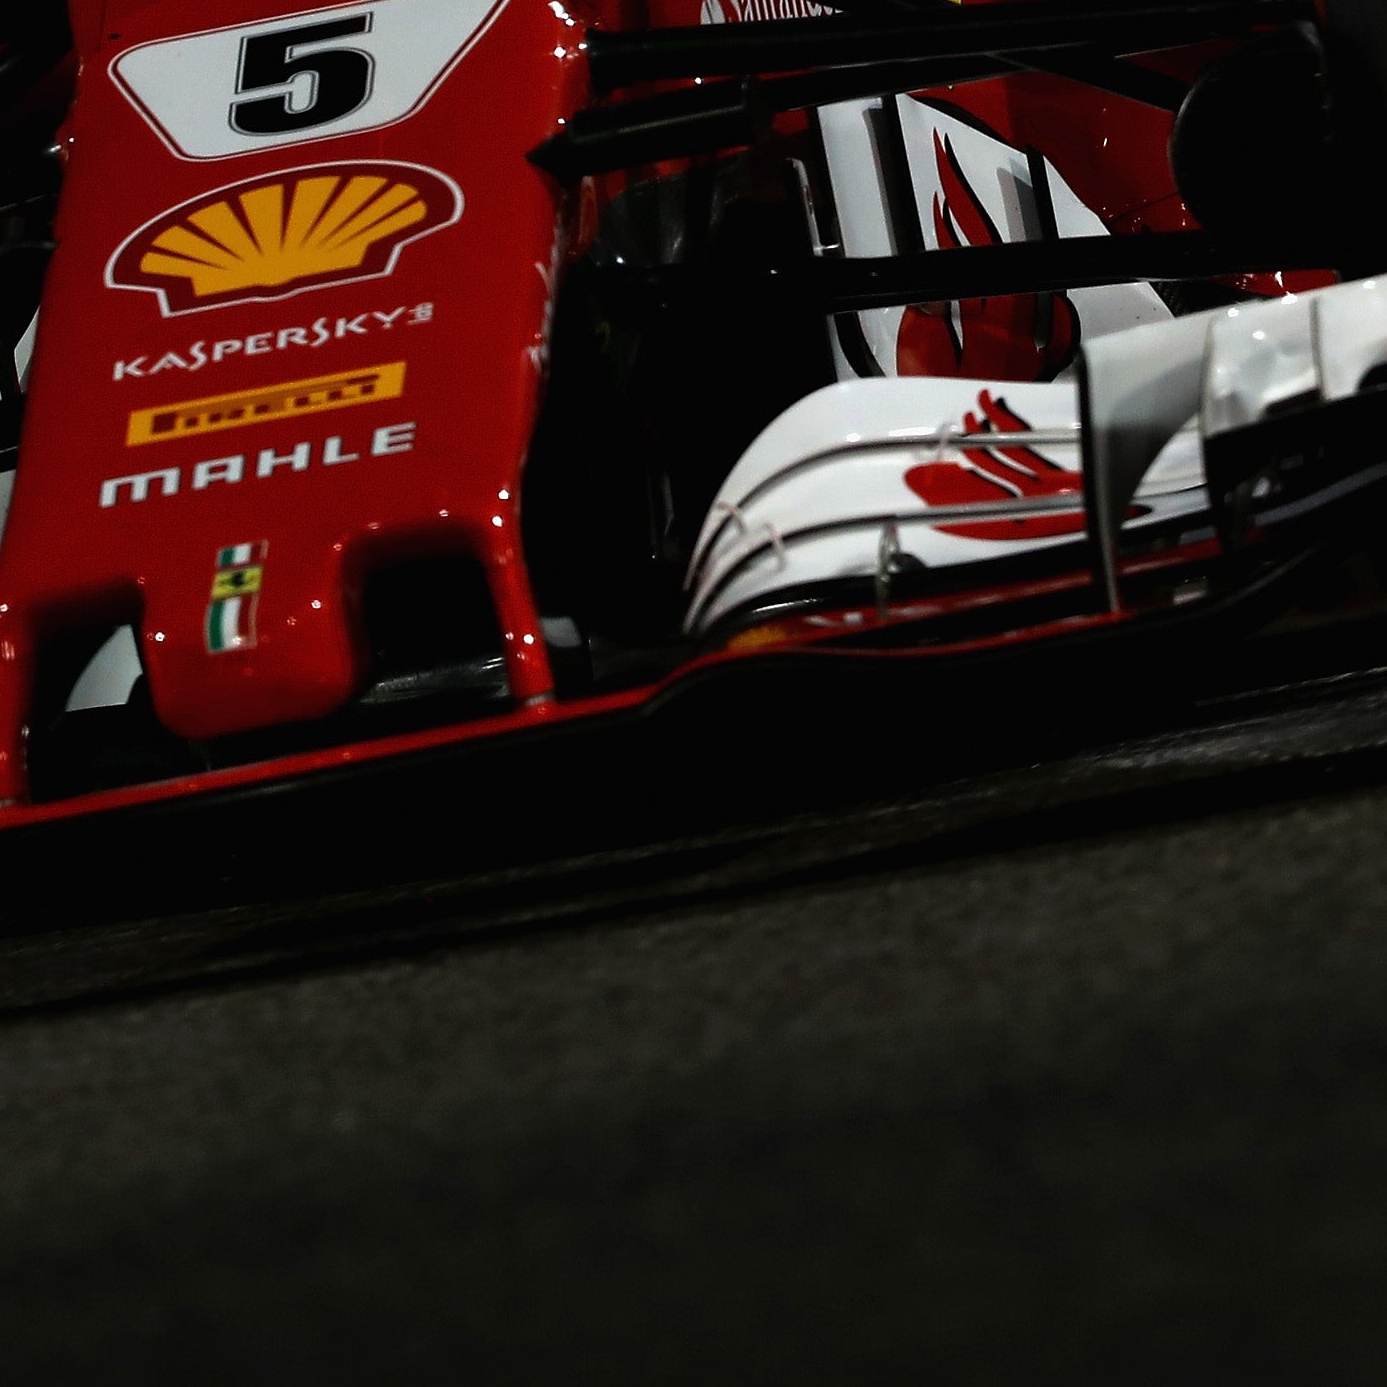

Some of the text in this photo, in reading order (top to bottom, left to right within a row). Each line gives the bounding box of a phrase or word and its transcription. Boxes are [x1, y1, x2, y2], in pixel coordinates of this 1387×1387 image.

[228, 11, 374, 136] 5
[112, 306, 406, 382] KASPERSKY
[98, 420, 418, 509] MAHLE
